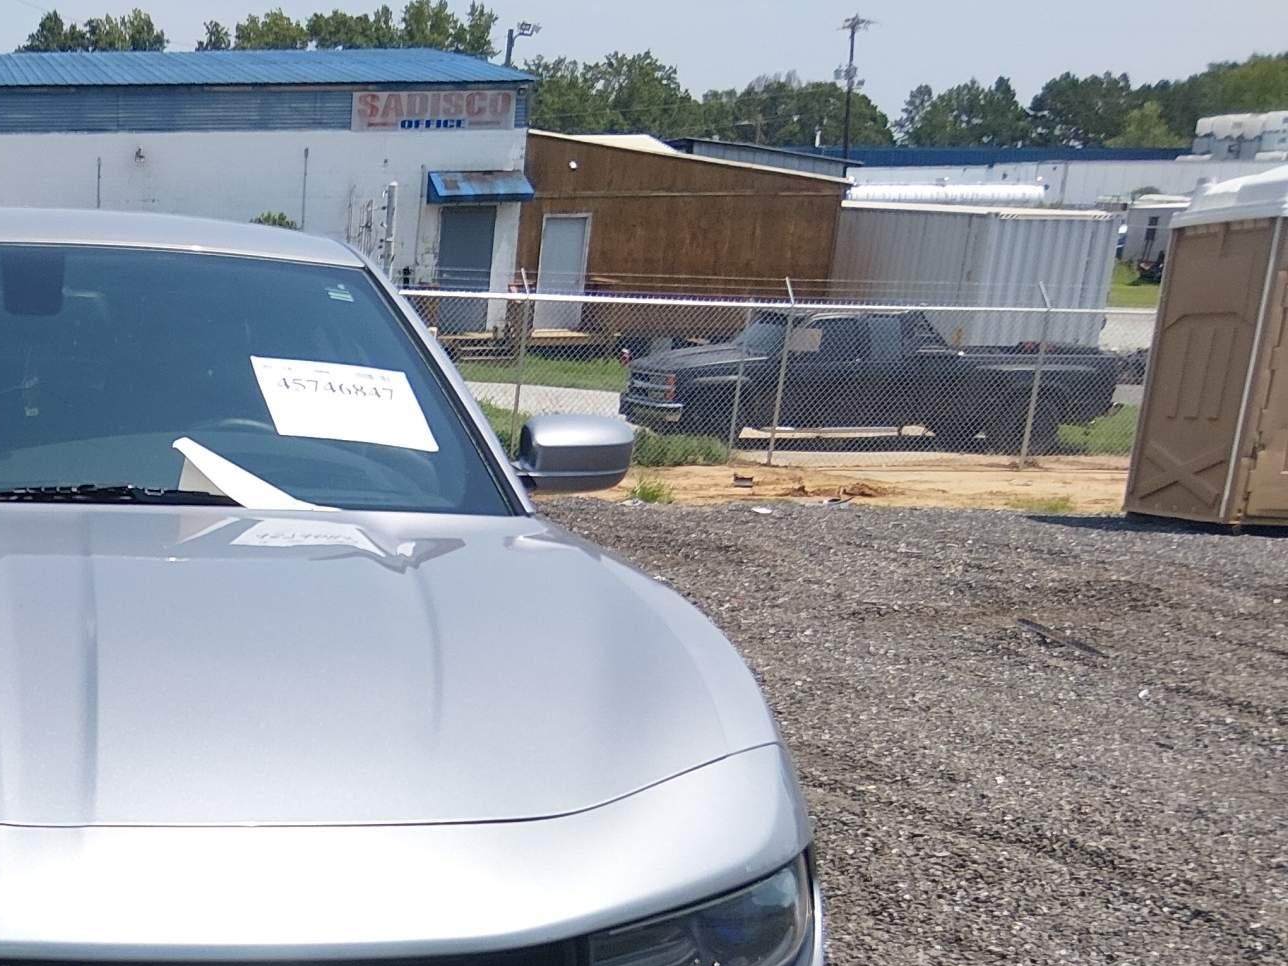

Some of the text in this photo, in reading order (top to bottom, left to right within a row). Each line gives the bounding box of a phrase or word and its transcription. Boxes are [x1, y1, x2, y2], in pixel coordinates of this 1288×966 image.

[357, 92, 512, 118] SADISCO
[400, 118, 466, 130] OFFICE
[277, 377, 395, 401] 45746847
